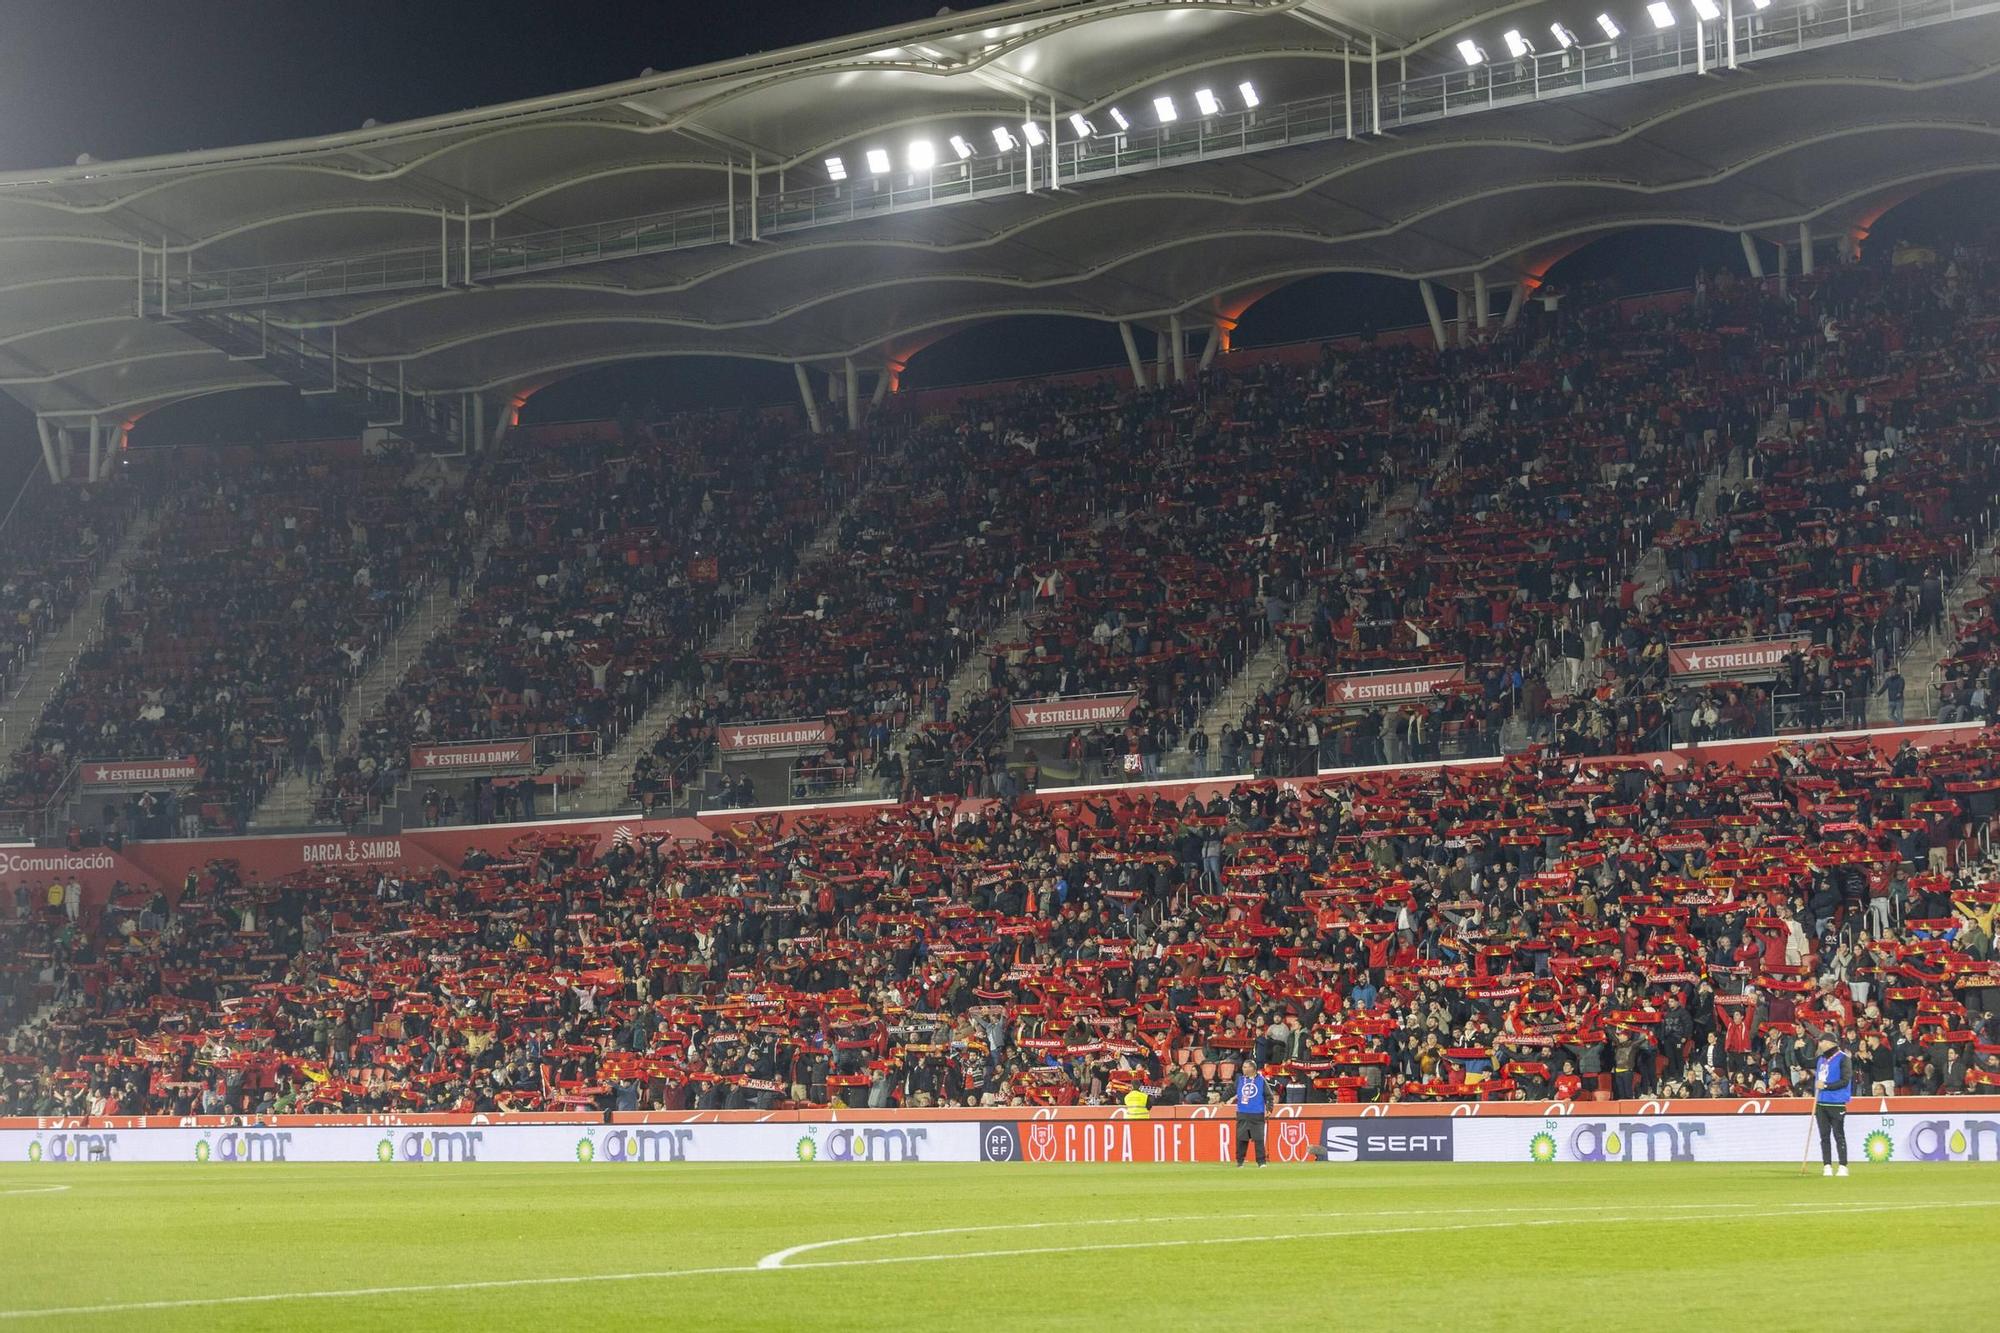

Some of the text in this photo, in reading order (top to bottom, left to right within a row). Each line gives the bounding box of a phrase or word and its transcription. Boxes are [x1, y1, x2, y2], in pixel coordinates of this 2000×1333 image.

[1704, 653, 1764, 669] ESTRELLA
[1358, 684, 1412, 698] ESTRELLA
[1040, 706, 1126, 723] ESTRELLA DAMM
[747, 730, 825, 745] ESTRELLA DAMM
[439, 752, 486, 765] ESTRELLA
[111, 767, 195, 780] ESTRELLA DAMM
[303, 841, 401, 862] BARCA SAMBA
[9, 853, 114, 871] Comunicación
[1491, 987, 1520, 996] MALLORCA
[1078, 1043, 1102, 1051] MALLORCA
[808, 1125, 817, 1134] bp
[1545, 1119, 1558, 1130] bp
[1881, 1117, 1895, 1128] bp
[1065, 1123, 1133, 1162] COPA
[1368, 1136, 1448, 1152] SEAT
